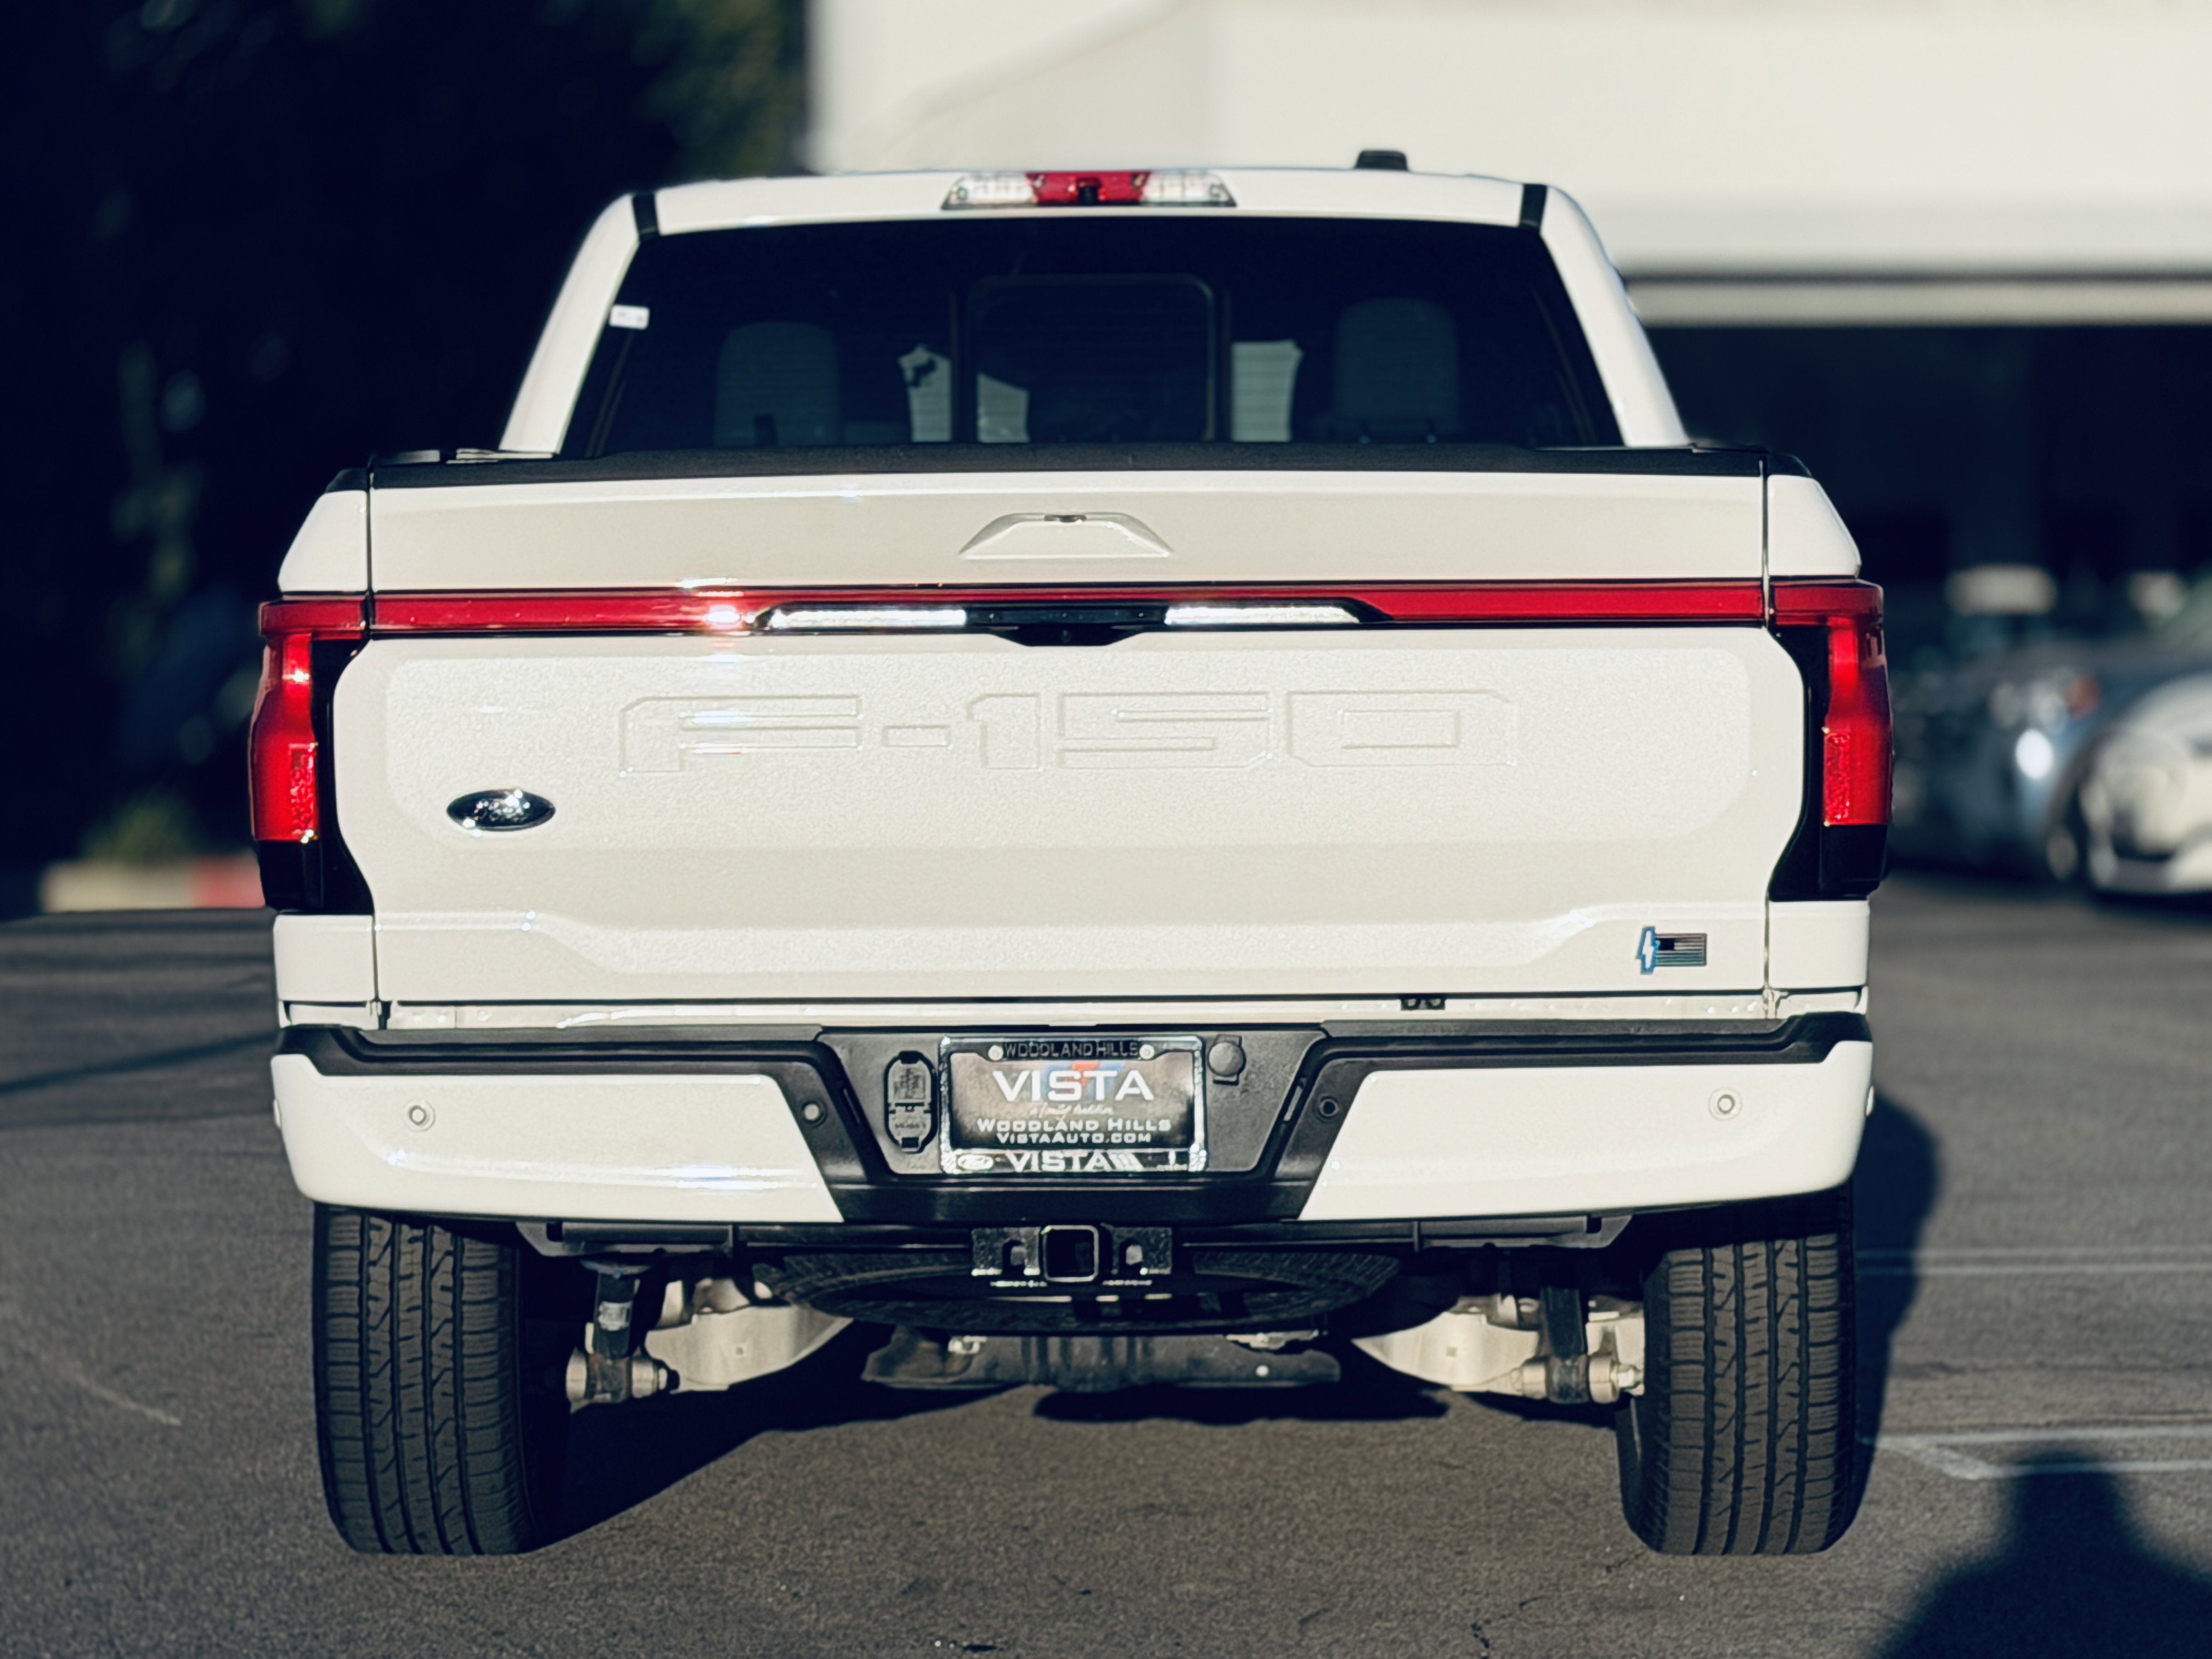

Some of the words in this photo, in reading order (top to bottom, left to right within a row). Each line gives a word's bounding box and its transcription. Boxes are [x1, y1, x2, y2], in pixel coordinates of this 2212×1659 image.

[619, 690, 1521, 775] F-150
[1005, 1042, 1093, 1058] WOODLAND
[1097, 1041, 1138, 1056] HILLS
[992, 1070, 1154, 1101] VISTA
[978, 1118, 1099, 1132] WOODLAND
[1108, 1118, 1172, 1131] HILLS
[1006, 1150, 1113, 1172] VISTA
